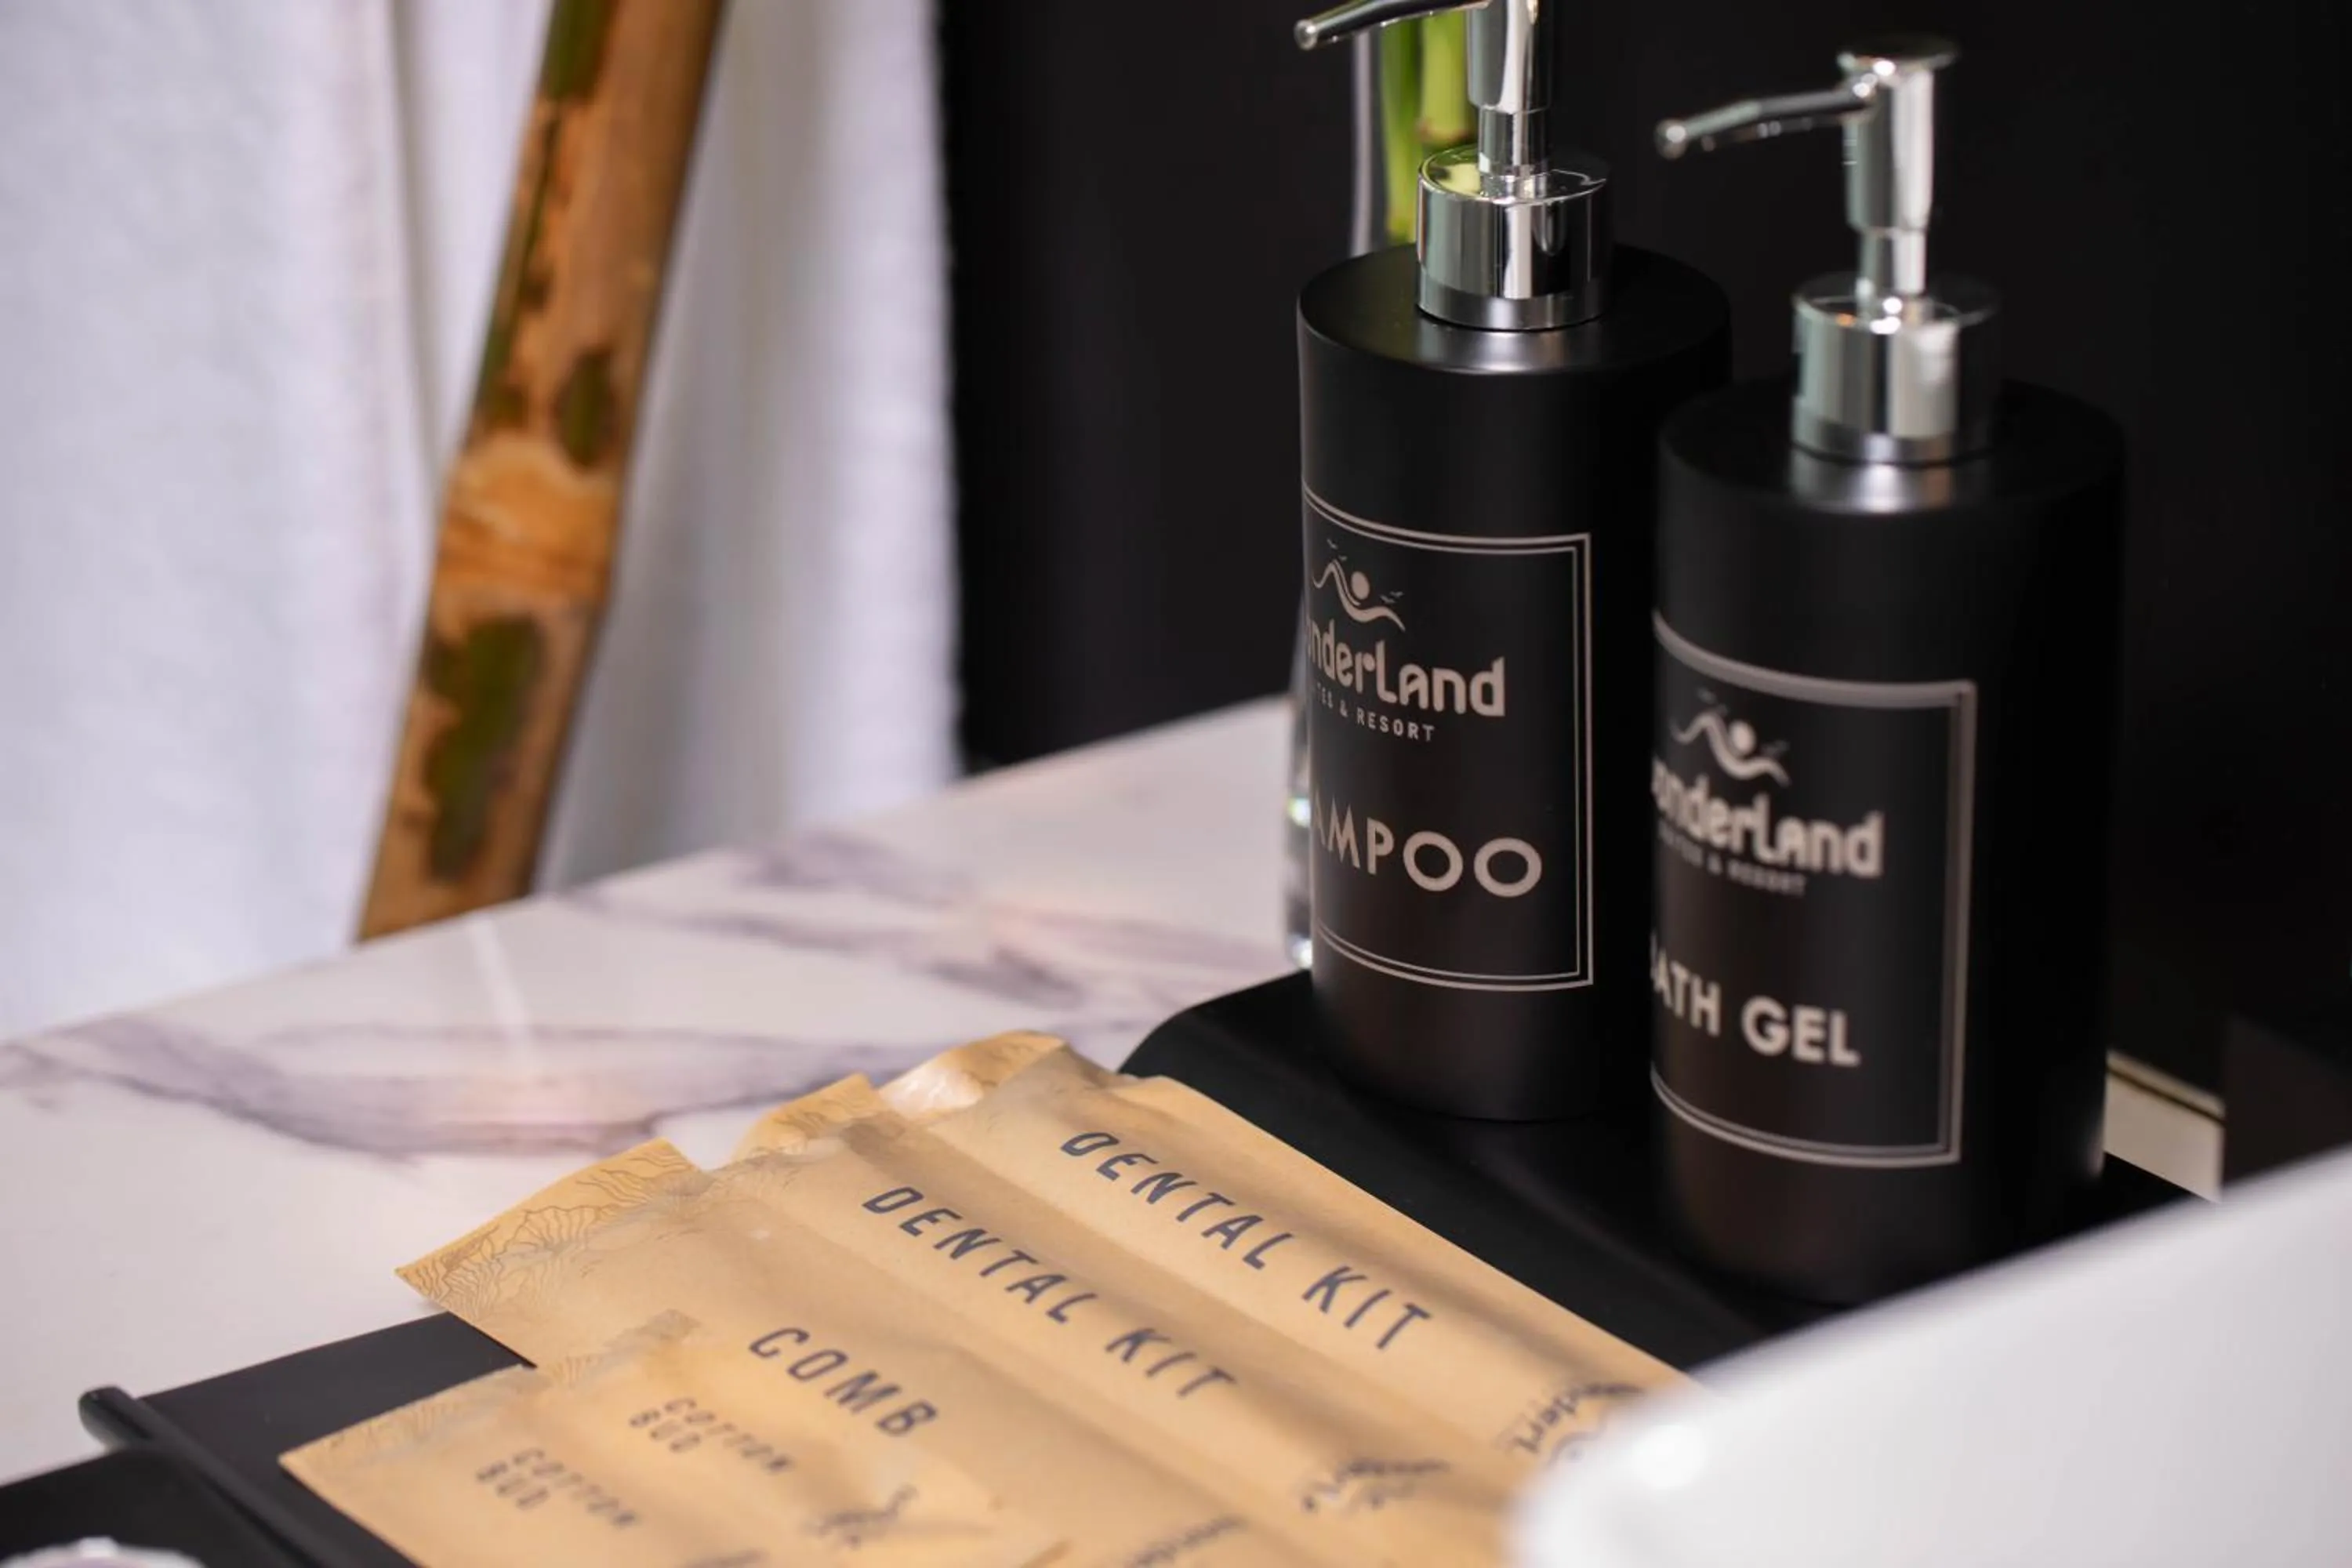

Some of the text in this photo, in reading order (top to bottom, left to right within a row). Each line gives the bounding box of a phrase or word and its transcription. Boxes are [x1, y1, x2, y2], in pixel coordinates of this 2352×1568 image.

[1307, 615, 1505, 717] nderLand
[1356, 706, 1435, 742] RESORT
[1740, 995, 1862, 1067] GEL
[862, 1186, 1237, 1397] DENTAL KIT
[1060, 1131, 1432, 1350] DENTAL KIT
[748, 1327, 938, 1437] COMB
